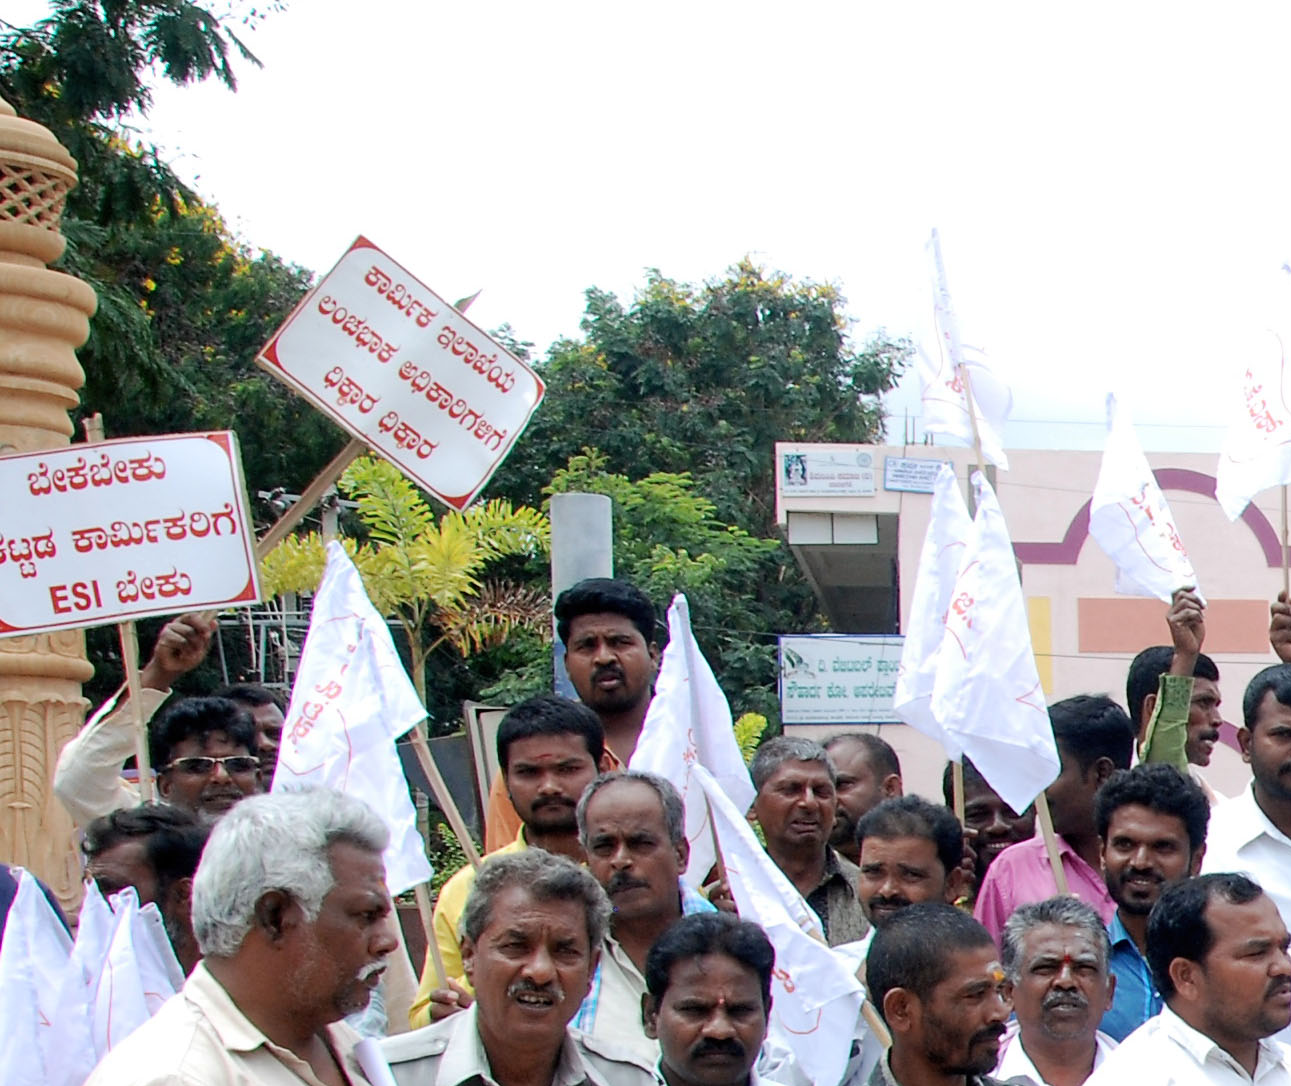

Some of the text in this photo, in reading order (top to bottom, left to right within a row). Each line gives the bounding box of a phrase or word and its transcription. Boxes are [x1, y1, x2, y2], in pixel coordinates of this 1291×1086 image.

[364, 264, 516, 394] ಕಾರ್ಮಿಕ ಇಲಾಖೆಯ
[398, 358, 508, 452] ಅಧಿಕಾರಿಗಳಿಗೆ
[28, 454, 167, 497] ಬೇಕೆಬೇಕು
[72, 503, 238, 553] ಕಾರ್ಮಿಕರಿಗೆ
[49, 570, 193, 615] ESI ಬೇಕು
